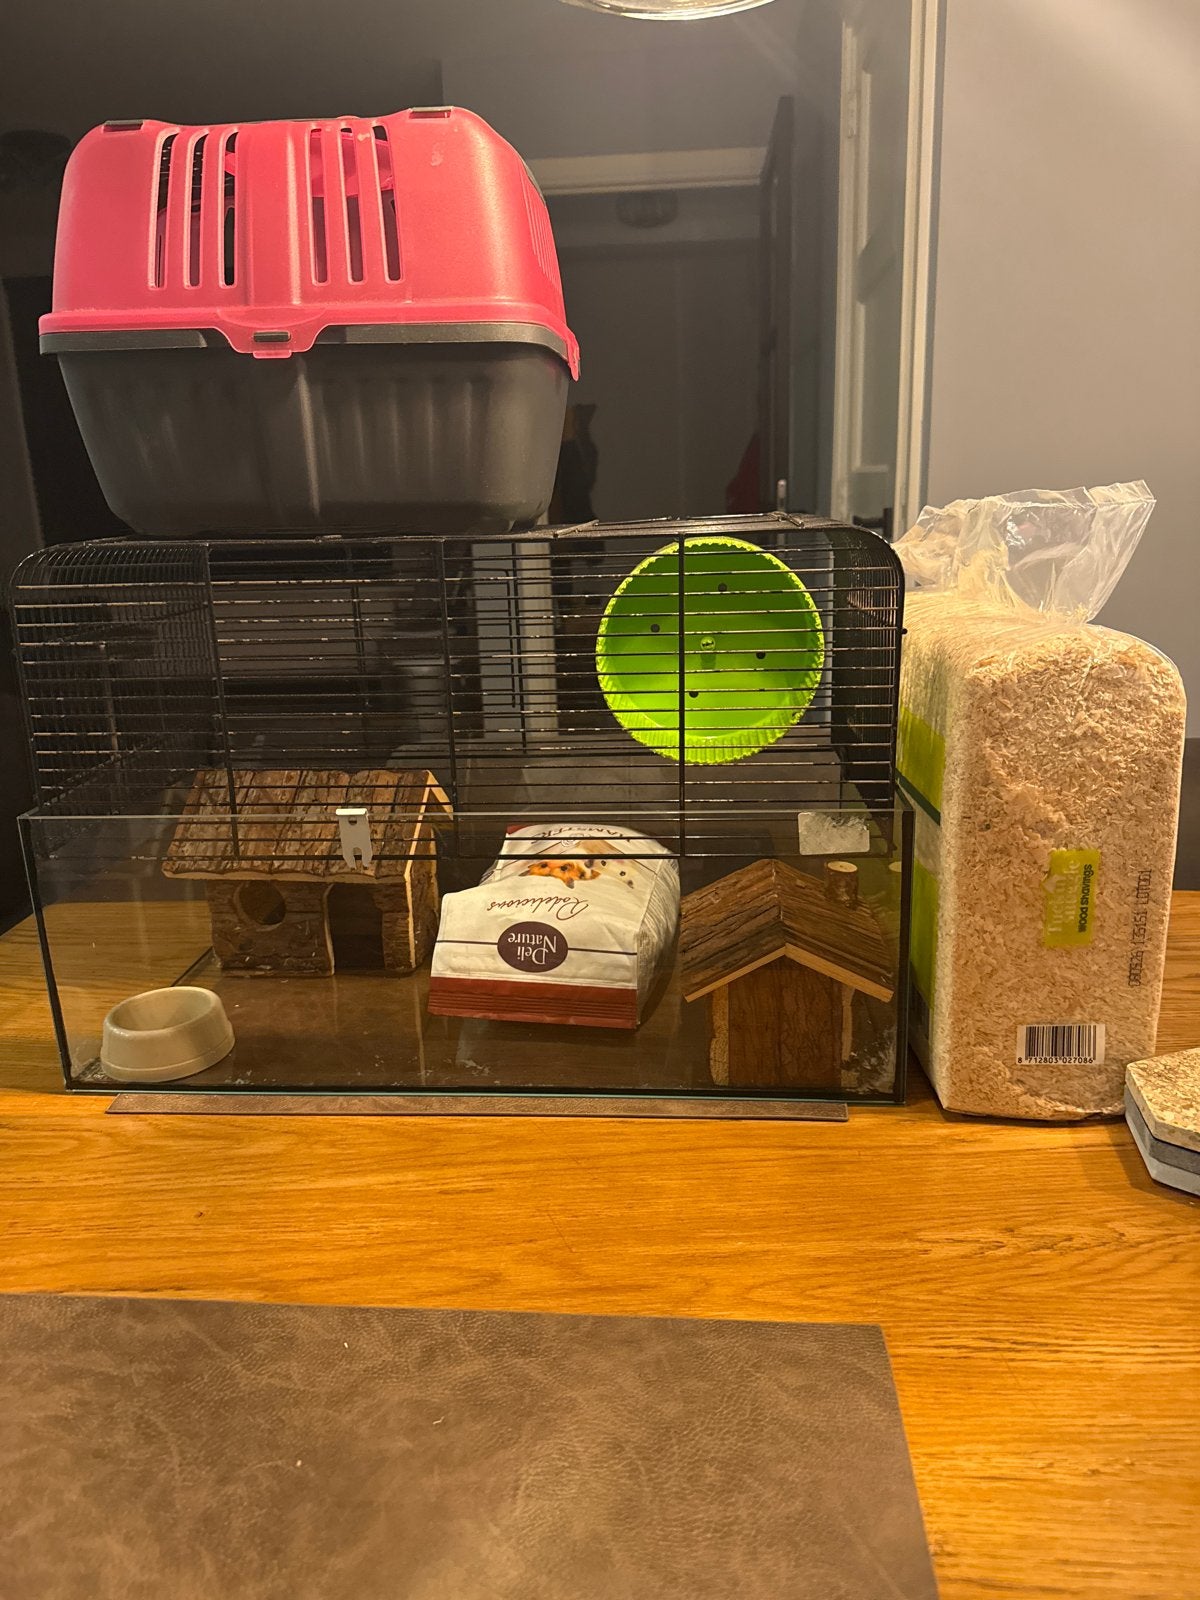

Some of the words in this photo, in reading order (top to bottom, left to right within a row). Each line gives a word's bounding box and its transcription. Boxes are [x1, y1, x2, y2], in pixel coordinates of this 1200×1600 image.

[1080, 864, 1095, 907] shavings
[487, 895, 589, 921] Rodelicious
[1078, 907, 1088, 933] wood
[507, 932, 557, 953] Nature
[517, 944, 549, 965] Deli
[1017, 1056, 1023, 1064] 8
[1028, 1056, 1059, 1064] 712803
[1062, 1056, 1094, 1064] 027086
